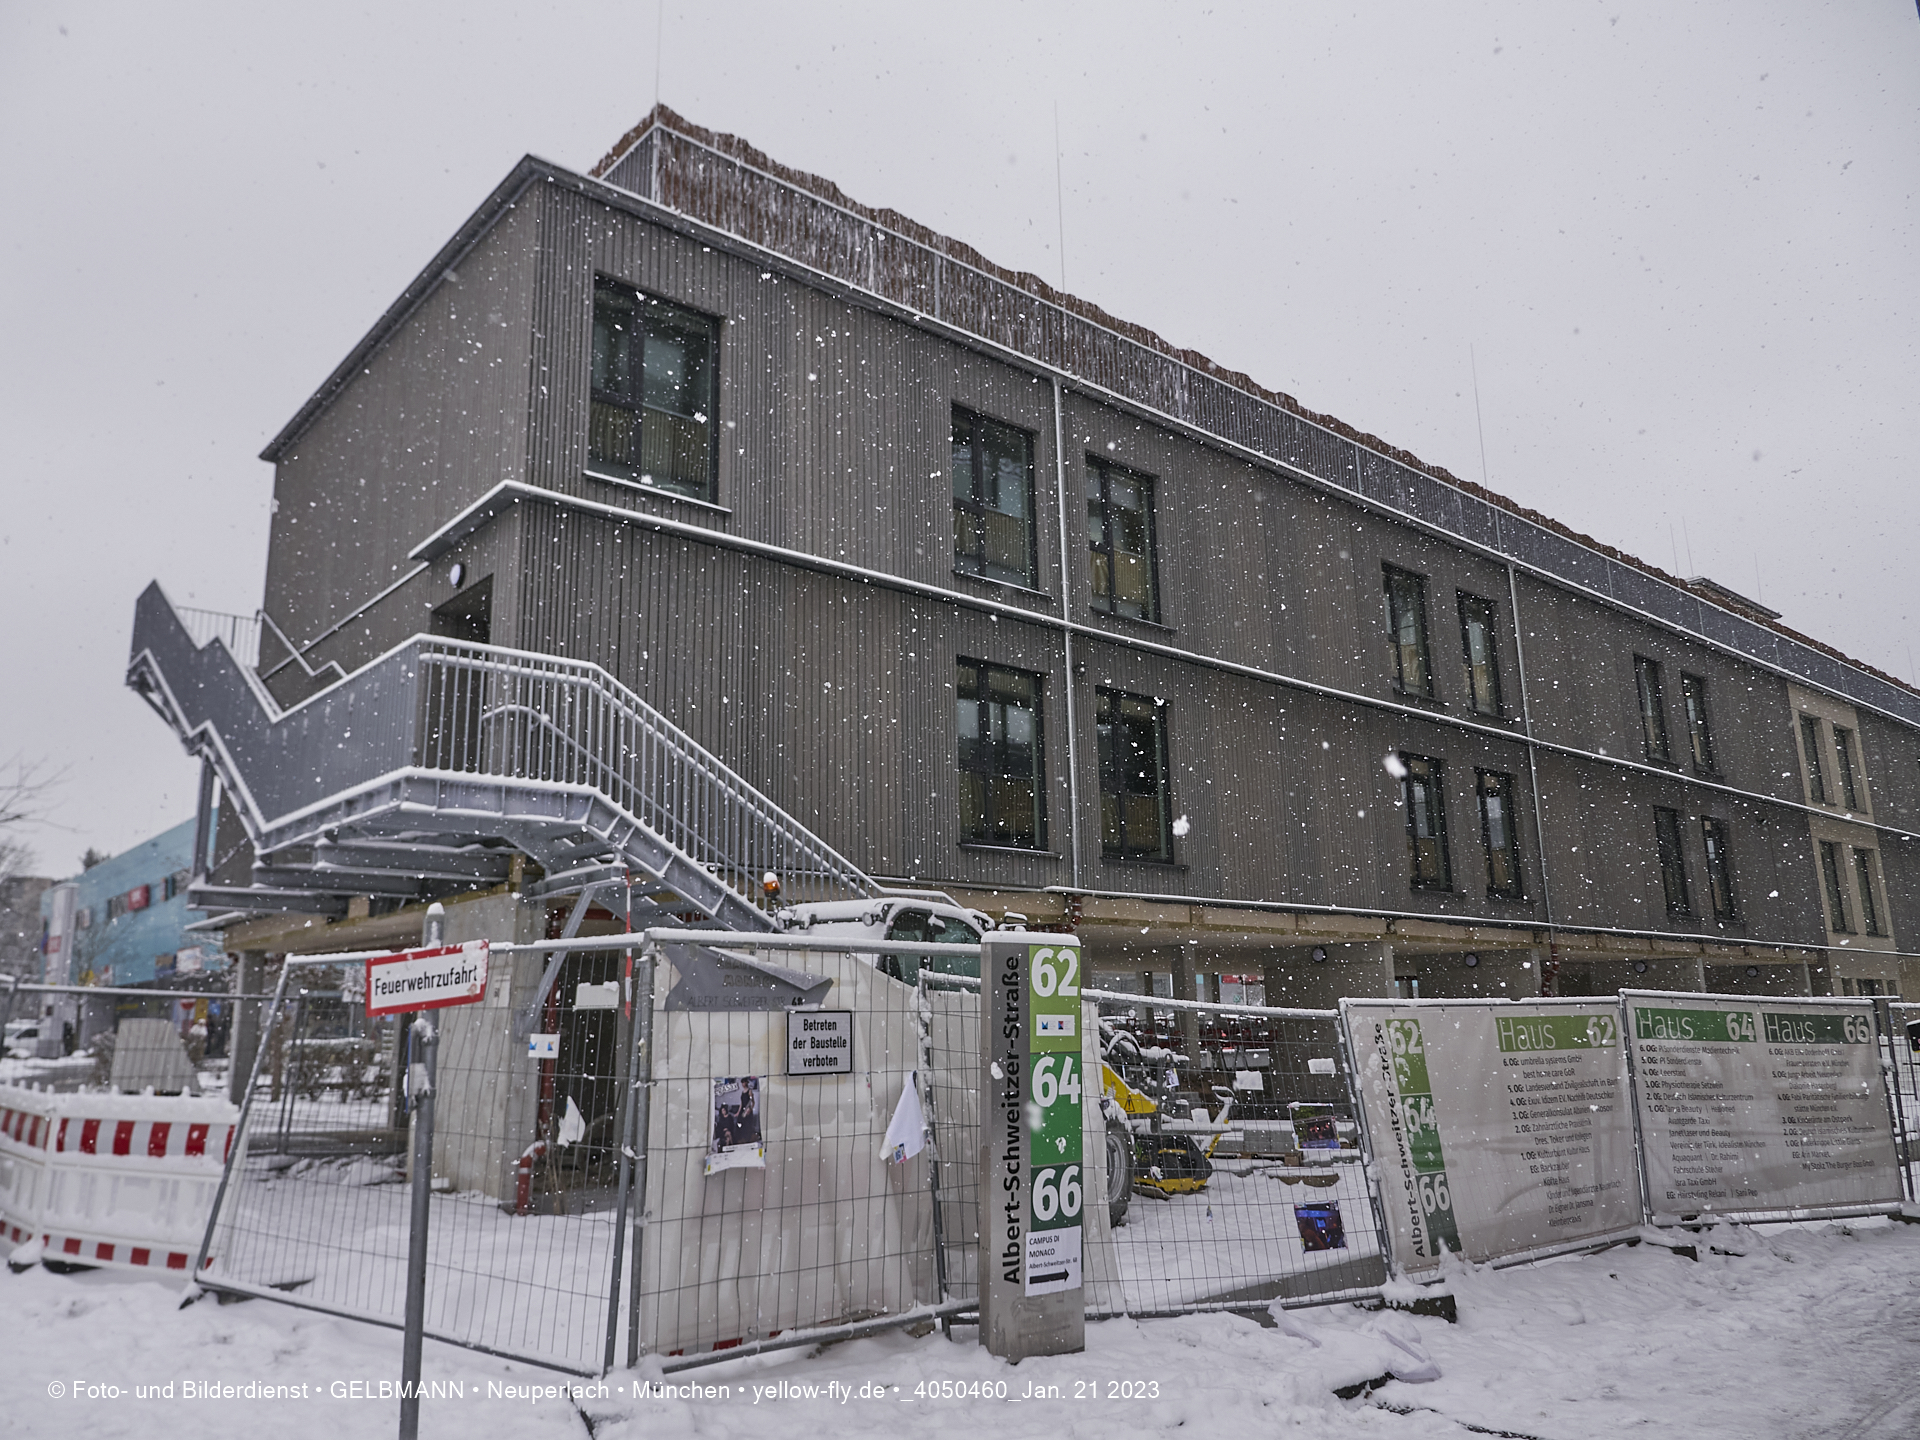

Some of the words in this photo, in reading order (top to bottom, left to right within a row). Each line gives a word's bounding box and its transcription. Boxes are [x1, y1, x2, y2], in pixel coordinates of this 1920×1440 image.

[375, 965, 477, 996] Feuerwehrzufahrt
[1031, 948, 1078, 997] 62
[804, 1019, 837, 1031] Betreten
[1389, 1020, 1422, 1055] 62
[1499, 1019, 1555, 1050] Haus
[1587, 1017, 1616, 1047] 62
[1637, 1009, 1693, 1039] Haus
[1726, 1013, 1755, 1041] 64
[1765, 1014, 1815, 1042] Haus
[1844, 1016, 1870, 1043] 66
[793, 1037, 806, 1049] der
[811, 1036, 847, 1049] Baustelle
[803, 1055, 838, 1067] verboten
[1521, 1057, 1544, 1065] umbrella
[1546, 1056, 1567, 1066] systems
[1523, 1070, 1535, 1079] best
[1032, 1056, 1081, 1107] 64
[1001, 956, 1020, 1285] Albert-Schweitzer-Straße
[1403, 1096, 1437, 1133] 64
[1513, 1112, 1518, 1120] 3.
[1033, 1165, 1081, 1221] 66
[1419, 1174, 1450, 1214] 66
[1029, 1236, 1052, 1245] CAMPUS
[1029, 1248, 1055, 1258] MONACO
